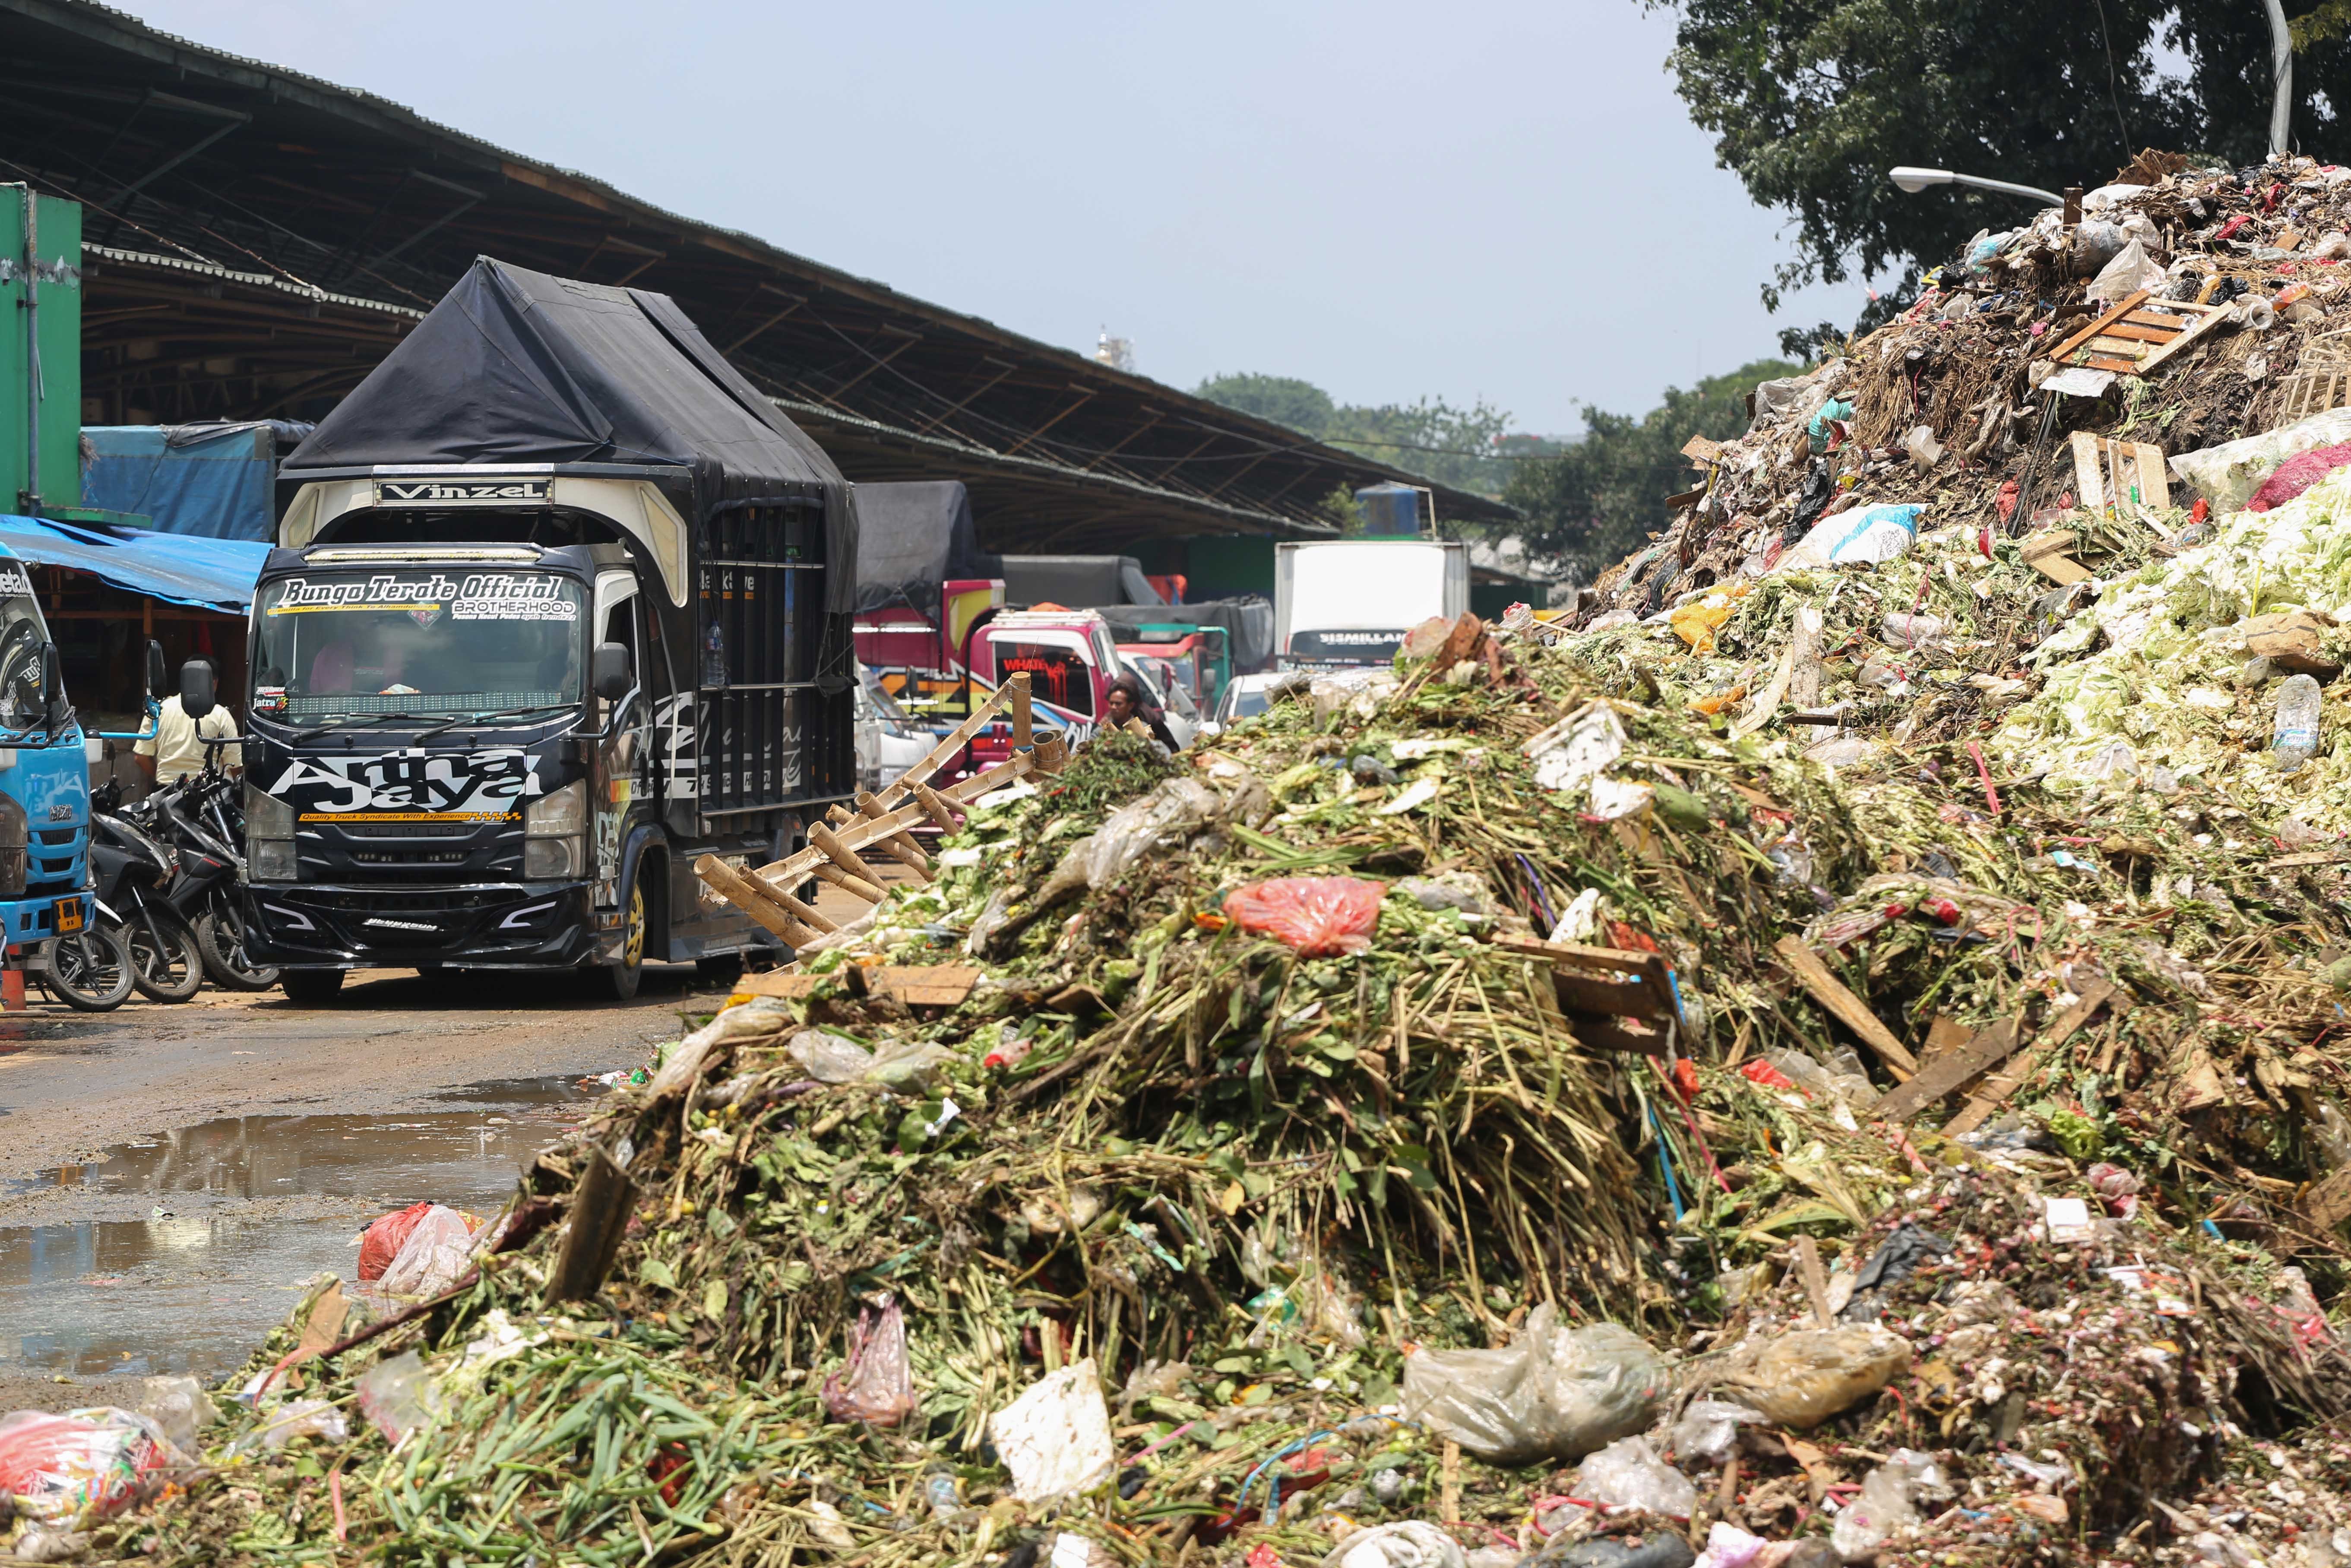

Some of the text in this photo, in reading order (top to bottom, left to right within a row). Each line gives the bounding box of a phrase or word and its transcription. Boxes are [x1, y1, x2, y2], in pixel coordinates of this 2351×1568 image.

[386, 484, 543, 499] Vinzel
[278, 575, 563, 605] Bunga Terate Official
[452, 600, 576, 614] BROTHERHOOD
[253, 698, 275, 710] Jatra
[313, 772, 544, 812] Jaya
[49, 805, 72, 822] ISUZU
[203, 857, 221, 868] HONDA
